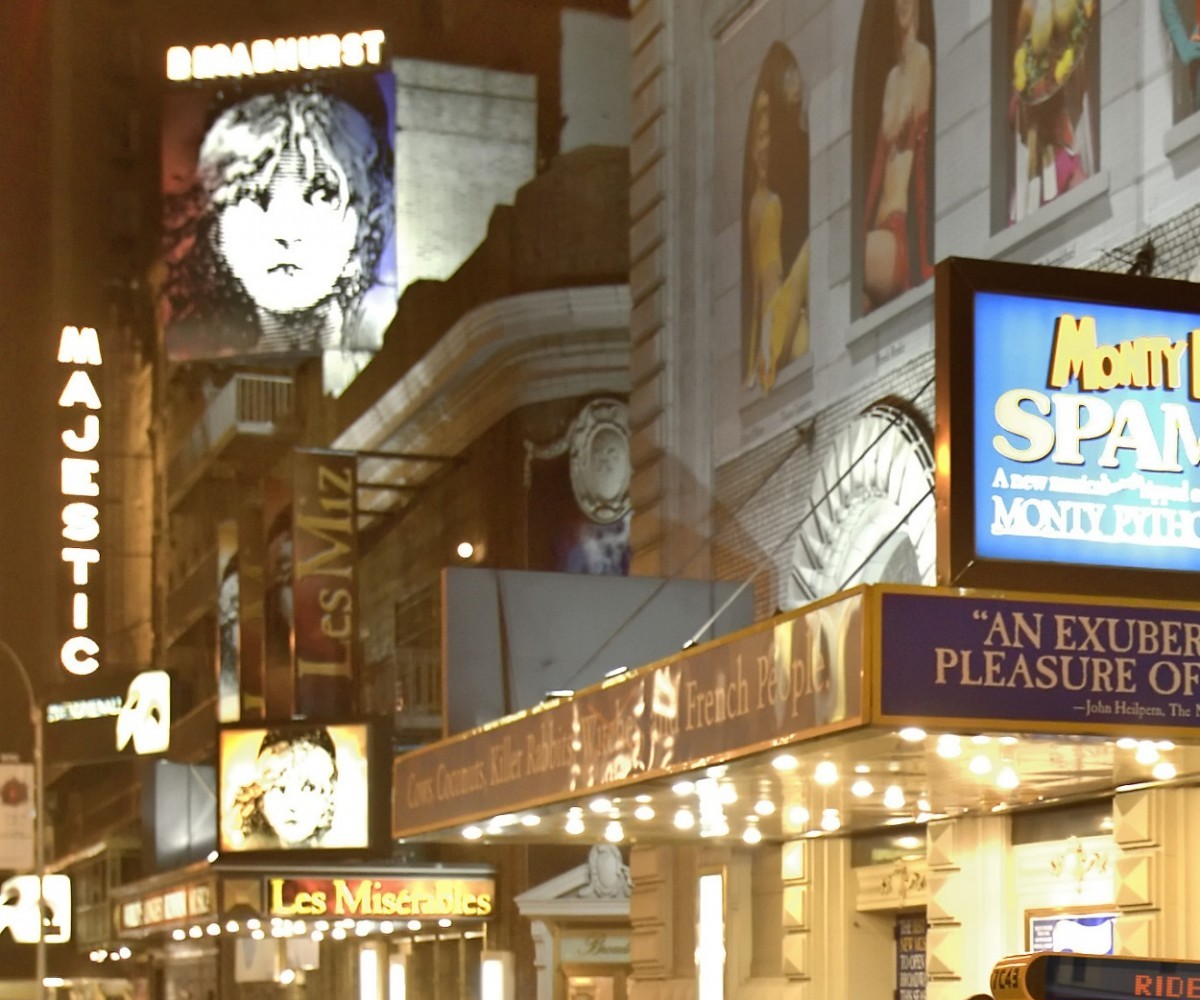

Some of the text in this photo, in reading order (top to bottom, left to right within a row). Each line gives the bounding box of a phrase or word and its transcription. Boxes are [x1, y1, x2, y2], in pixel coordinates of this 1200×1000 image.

[166, 29, 386, 81] BROADHURST
[1046, 314, 1187, 392] MONTY
[57, 326, 102, 676] MAJESTIC
[992, 467, 1009, 488] A
[991, 495, 1107, 536] MONTY
[298, 467, 353, 677] Les Miz
[685, 653, 750, 732] French
[934, 647, 1136, 694] PLEASURE
[1169, 703, 1190, 718] The
[269, 879, 326, 915] Les
